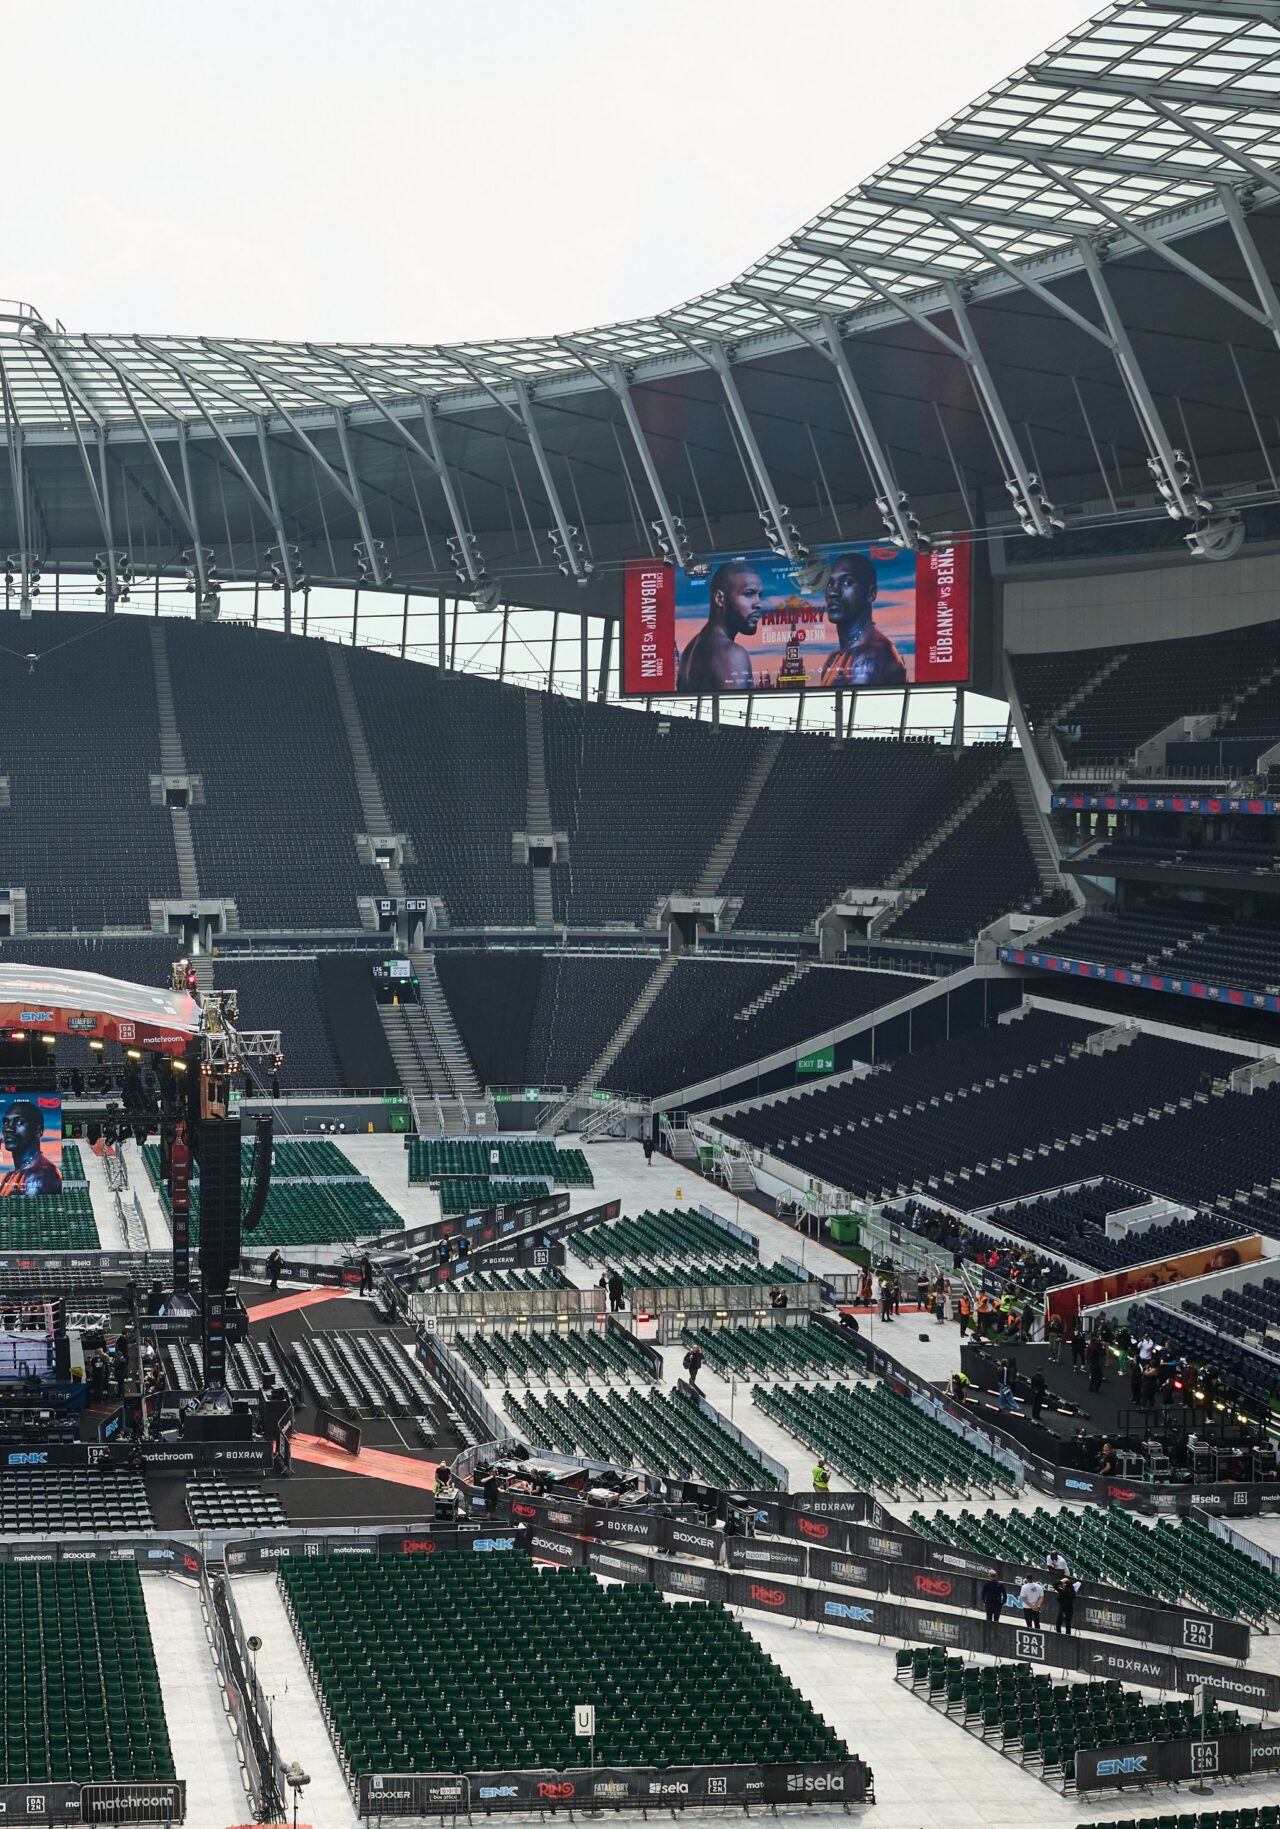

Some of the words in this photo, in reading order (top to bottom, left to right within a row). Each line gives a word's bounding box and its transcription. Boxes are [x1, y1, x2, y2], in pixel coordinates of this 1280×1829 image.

[641, 573, 656, 623] EUBANK
[941, 587, 951, 598] VS
[644, 632, 653, 642] VS
[937, 609, 953, 663] EUBANK
[641, 644, 656, 677] BENN
[21, 1011, 54, 1022] SNK
[798, 1060, 815, 1068] EXIT
[489, 1256, 514, 1265] BOXRAW
[8, 1452, 48, 1465] SNK
[1065, 1479, 1094, 1492] SNK
[1107, 1486, 1136, 1501] RING
[1200, 1494, 1220, 1504] sela
[511, 1503, 536, 1518] RING
[814, 1502, 855, 1511] BOXRAW
[608, 1521, 649, 1535] BOXRAW
[797, 1517, 829, 1539] RING
[473, 1538, 515, 1551] SNK
[531, 1536, 573, 1556] BOXXER
[673, 1531, 714, 1549] BOXXER
[269, 1547, 290, 1557] sela
[334, 1546, 371, 1554] matchroom
[402, 1540, 436, 1555] RING
[14, 1554, 52, 1562] matchroom
[589, 1553, 600, 1565] sky
[733, 1549, 745, 1560] sky
[781, 1555, 800, 1564] office
[932, 1552, 944, 1562] sky
[915, 1575, 952, 1597] RING
[749, 1584, 786, 1606] RING
[824, 1601, 874, 1623] SNK
[1108, 1656, 1161, 1677] BOXRAW
[1186, 1671, 1266, 1697] matchroom
[579, 1711, 589, 1728] U
[1096, 1756, 1147, 1777] SNK
[594, 1783, 612, 1792] FATAL
[613, 1783, 629, 1793] FURY
[661, 1782, 689, 1793] sela
[805, 1774, 844, 1791] sela
[368, 1791, 410, 1799] BOXXER
[479, 1786, 519, 1798] SNK
[537, 1782, 575, 1799] RING
[92, 1795, 173, 1811] matchroom
